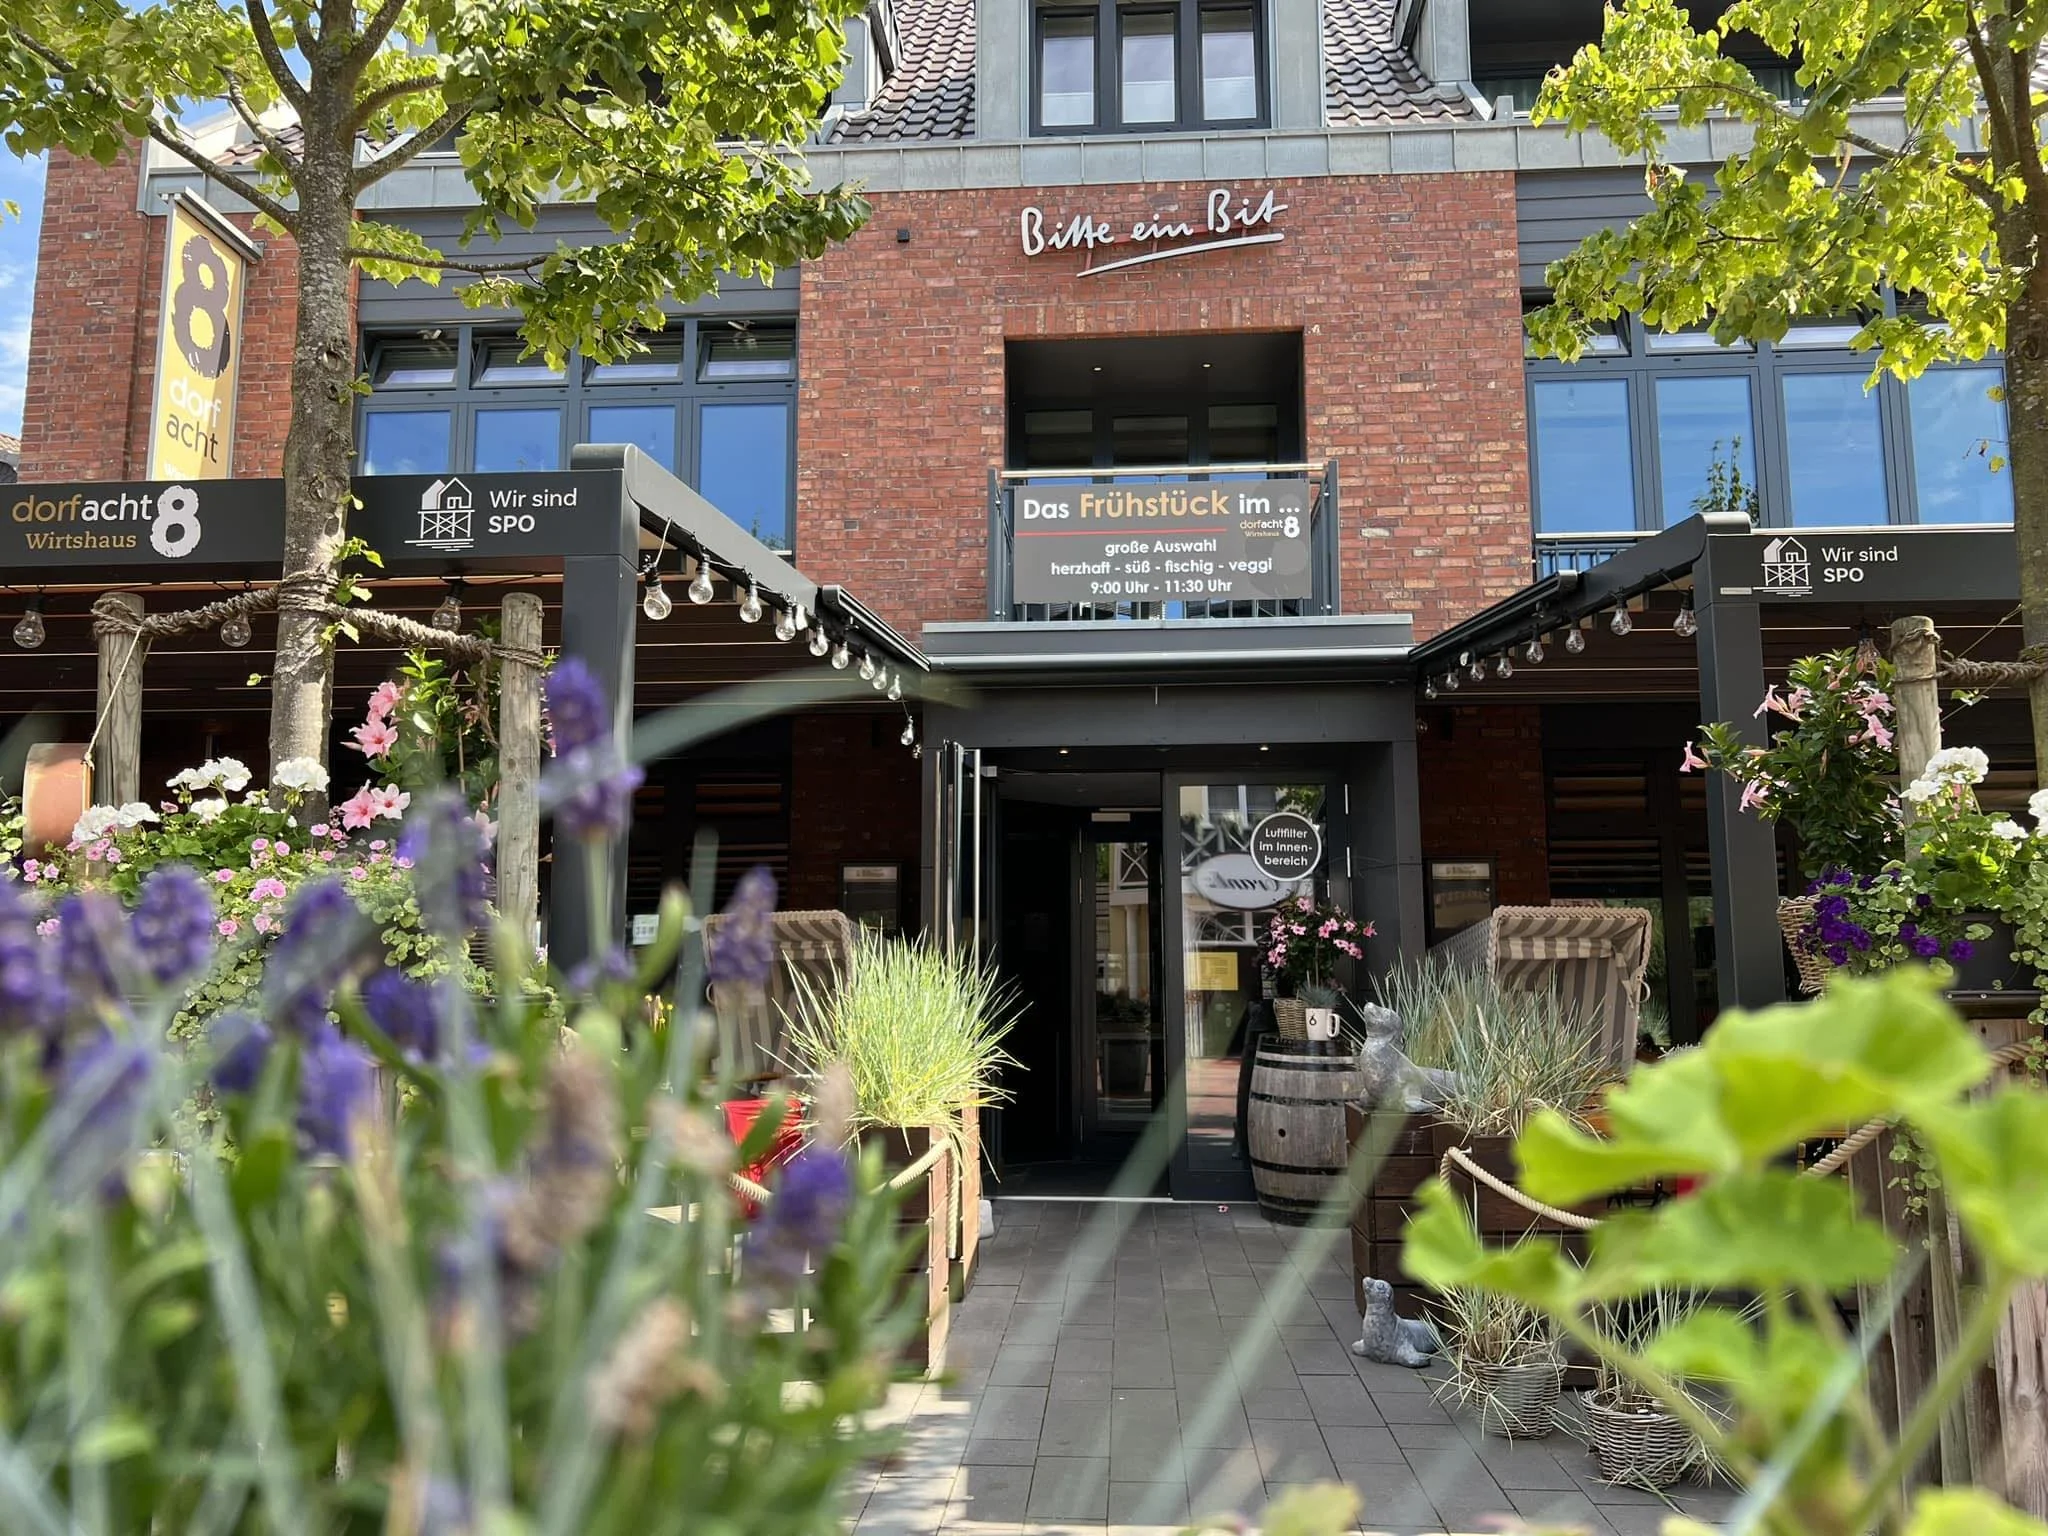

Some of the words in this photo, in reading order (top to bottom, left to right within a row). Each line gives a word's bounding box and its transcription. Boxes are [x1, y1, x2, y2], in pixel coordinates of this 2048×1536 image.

[1020, 207, 1115, 256] Bitte
[1130, 213, 1194, 241] ein
[1207, 189, 1288, 232] Bit
[171, 233, 230, 379] 8
[169, 375, 221, 428] dorf
[166, 413, 219, 464] acht
[489, 489, 527, 508] Wir
[531, 487, 577, 507] sind
[1023, 499, 1070, 520] Das
[1080, 490, 1230, 519] Frühstück
[1239, 493, 1270, 514] im
[11, 493, 153, 522] dorfacht
[150, 485, 202, 558] 8
[488, 515, 536, 533] SPO
[1240, 519, 1283, 529] dorfacht
[1284, 516, 1300, 538] 8
[25, 531, 137, 549] Wirtshaus
[1105, 541, 1149, 557] große
[1154, 540, 1217, 553] Auswahl
[1821, 547, 1854, 562] Wir
[1859, 545, 1898, 562] sind
[1051, 562, 1110, 575] herzhaft
[1125, 560, 1150, 574] süß
[1165, 560, 1213, 575] fischig
[1229, 558, 1272, 574] veggi
[1823, 567, 1864, 583] SPO
[1091, 582, 1121, 595] 9:00
[1125, 582, 1150, 594] Uhr
[1165, 580, 1204, 593] 11:30
[1208, 579, 1232, 592] Uhr
[1265, 828, 1308, 839] Luftfilter
[1260, 841, 1273, 851] im
[1276, 841, 1313, 852] Innen-
[1264, 855, 1308, 866] bereich
